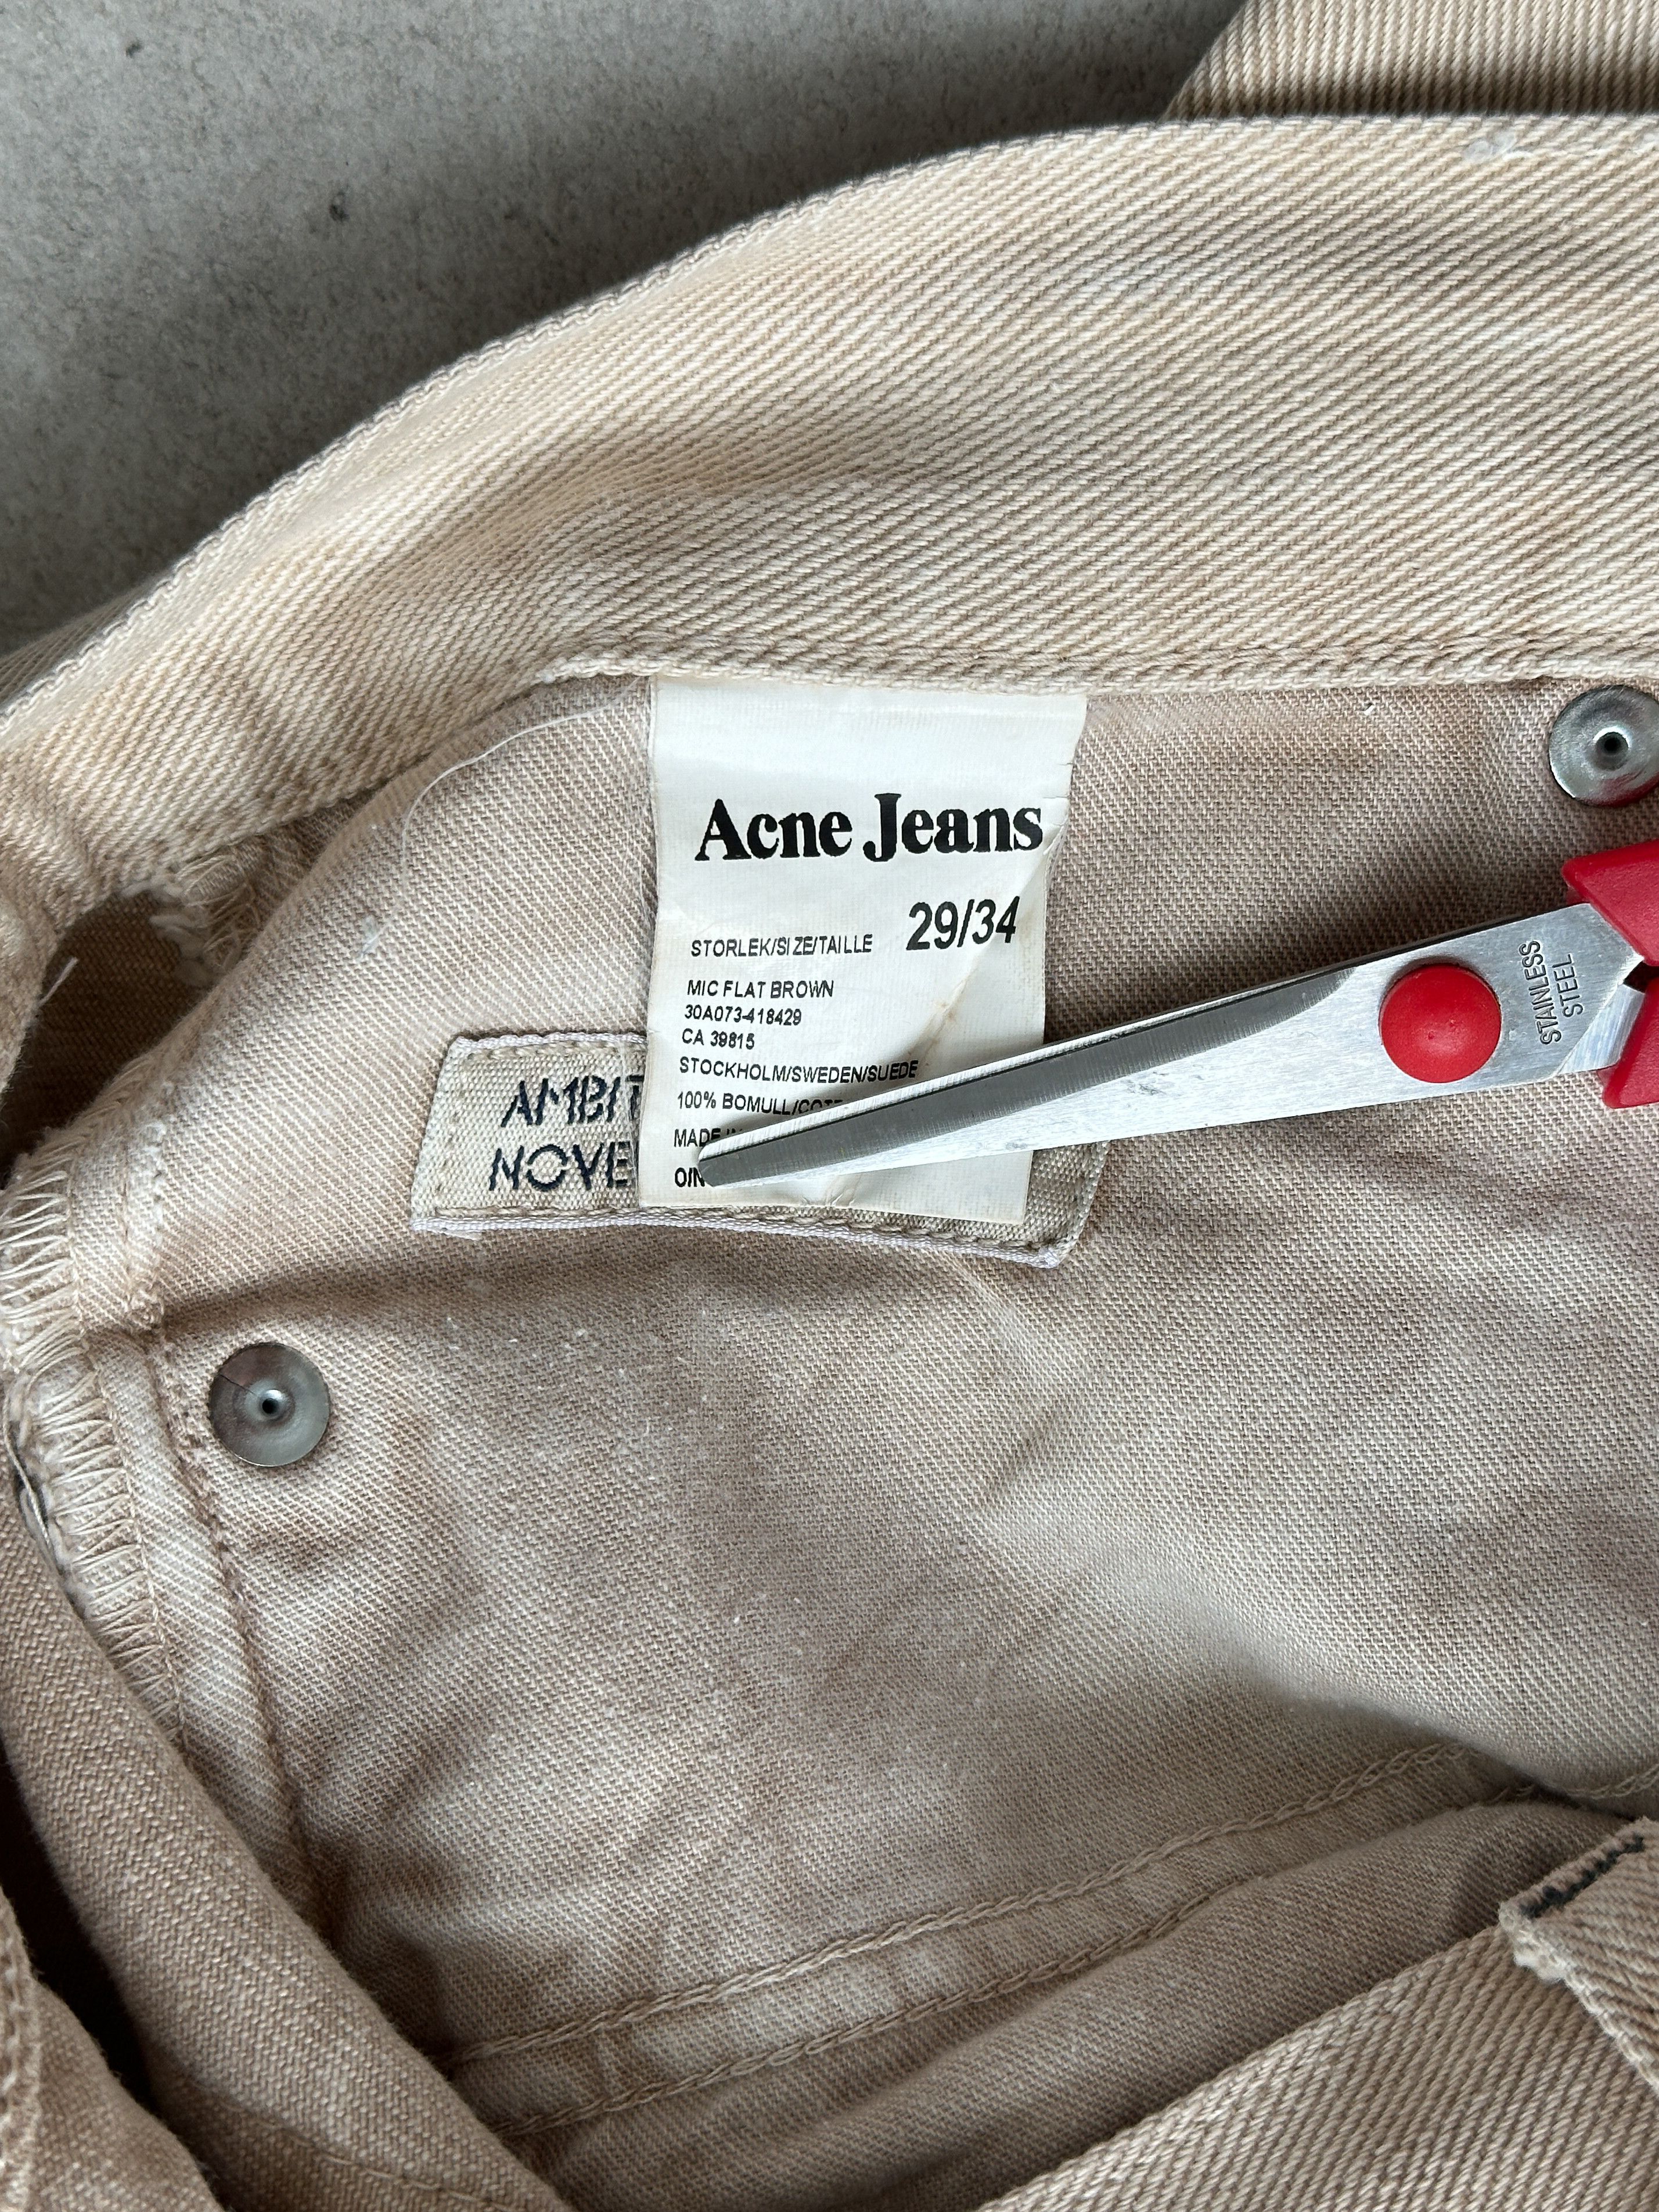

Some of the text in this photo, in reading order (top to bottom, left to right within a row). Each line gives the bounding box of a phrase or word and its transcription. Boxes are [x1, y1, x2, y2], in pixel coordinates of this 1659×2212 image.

[694, 792, 1043, 862] Acne Jeans
[691, 895, 1021, 957] STORLEK/SIZE/TAILLE 29/34
[686, 979, 834, 998] MIC FLAT BROWN
[1518, 940, 1562, 1045] STAINLESS
[1552, 954, 1584, 1017] STEEL
[684, 1004, 802, 1026] 30A073-418429
[682, 1028, 704, 1046] CA
[679, 1056, 919, 1084] STOCKHOLM/SWEDEN/SUEDE
[677, 1091, 843, 1116] 100% BOMULL/CO
